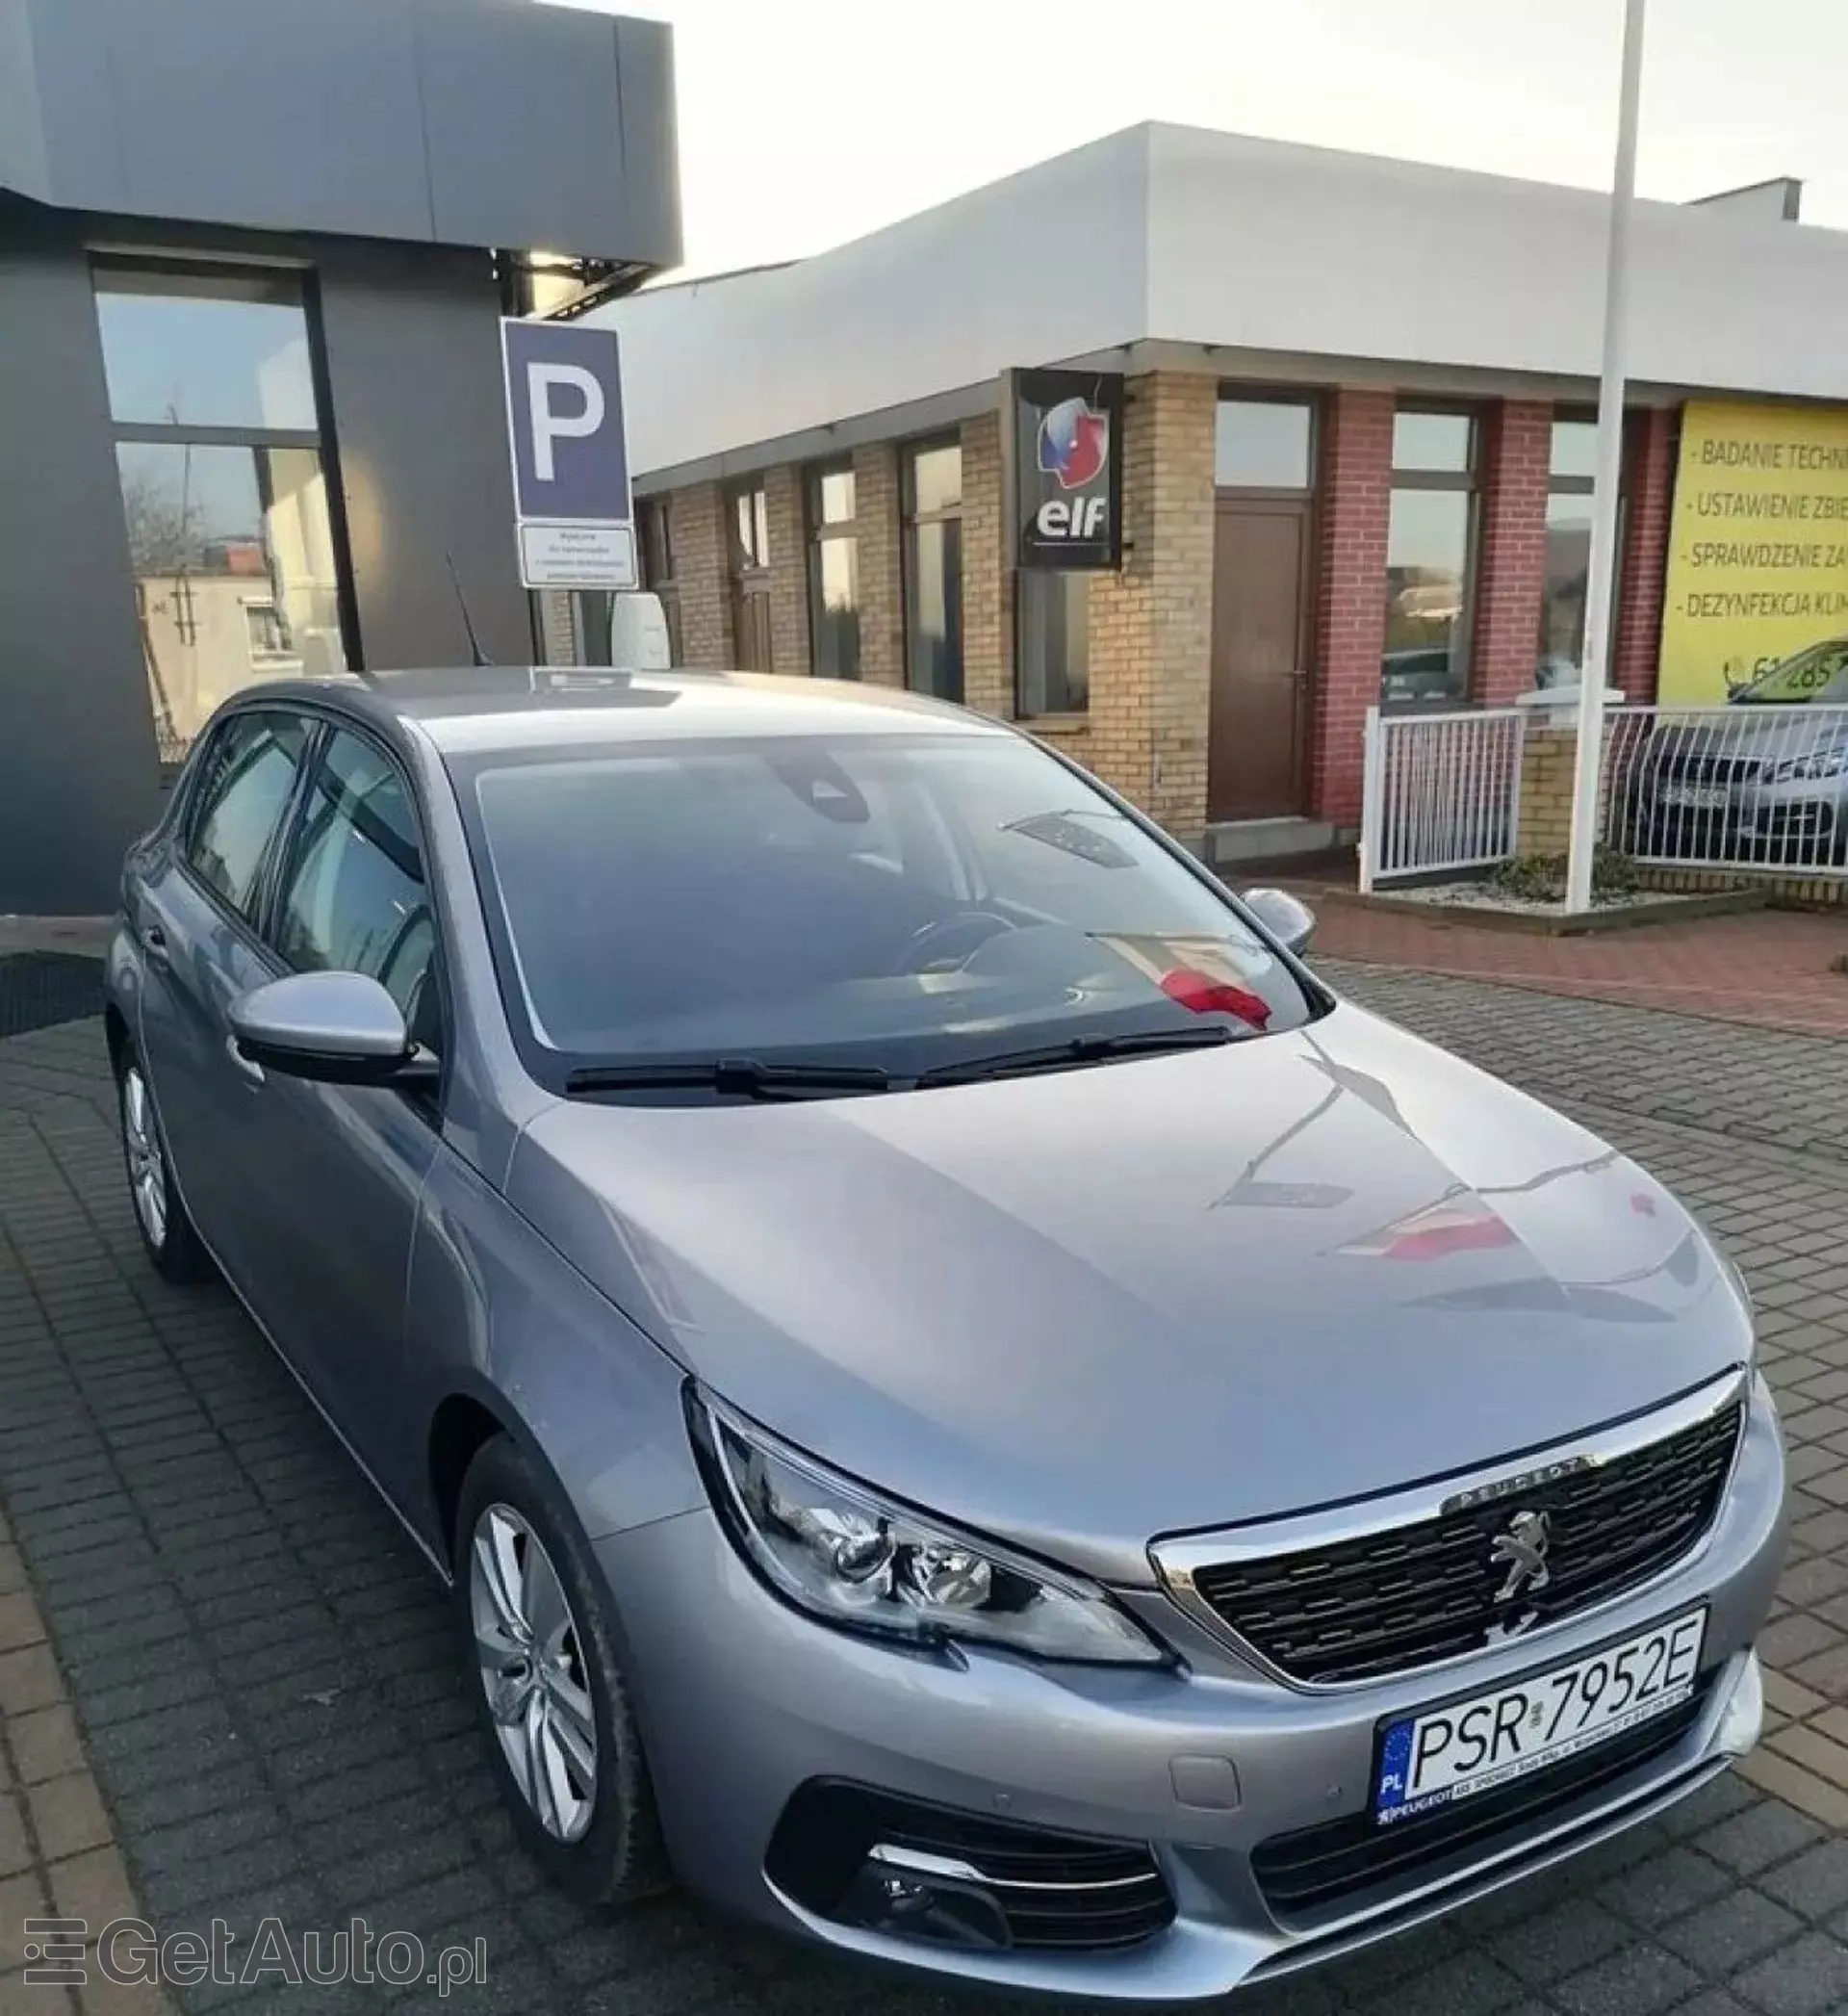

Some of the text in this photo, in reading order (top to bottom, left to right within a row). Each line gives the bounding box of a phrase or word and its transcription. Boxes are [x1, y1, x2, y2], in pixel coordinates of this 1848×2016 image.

[527, 362, 605, 481] P
[1702, 439, 1784, 469] BADANIE
[1037, 497, 1107, 538] elf
[1698, 492, 1810, 519] USTAWIENIE
[1691, 543, 1821, 568] SPRAWDZENIE
[1687, 593, 1810, 617] DEZYNFEKCJA
[1411, 1692, 1528, 1788] PSR
[1544, 1619, 1699, 1742] 7952E
[1380, 1772, 1403, 1795] PL
